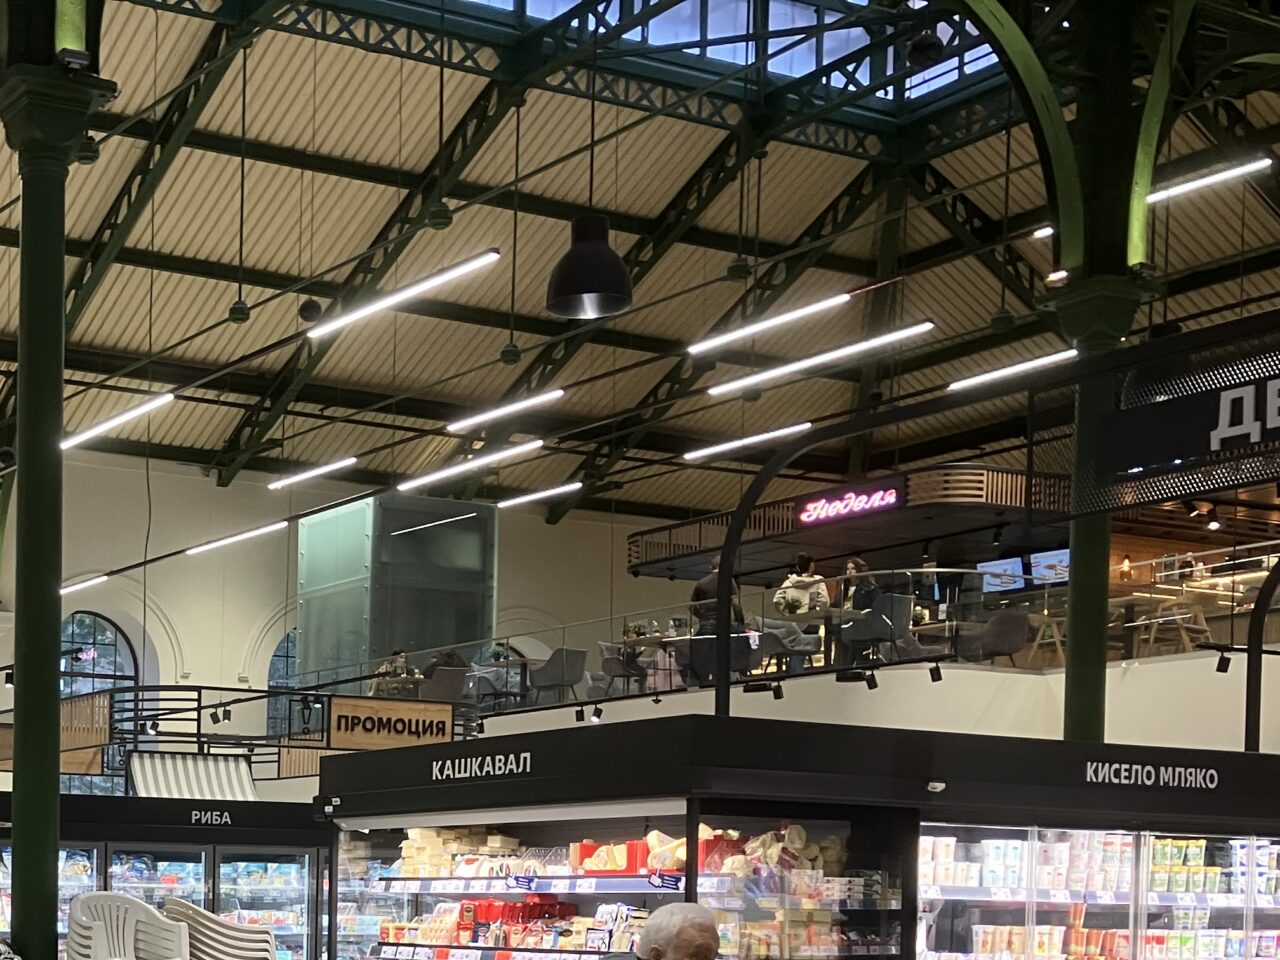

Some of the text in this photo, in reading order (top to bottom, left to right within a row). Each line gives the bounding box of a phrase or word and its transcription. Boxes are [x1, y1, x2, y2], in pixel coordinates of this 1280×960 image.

[336, 714, 446, 739] ПРОМОЦИЯ
[432, 752, 531, 780] КАШКАВАЛ
[1086, 761, 1218, 789] КИСЕЛО МЛЯКО
[191, 810, 232, 825] РИБА
